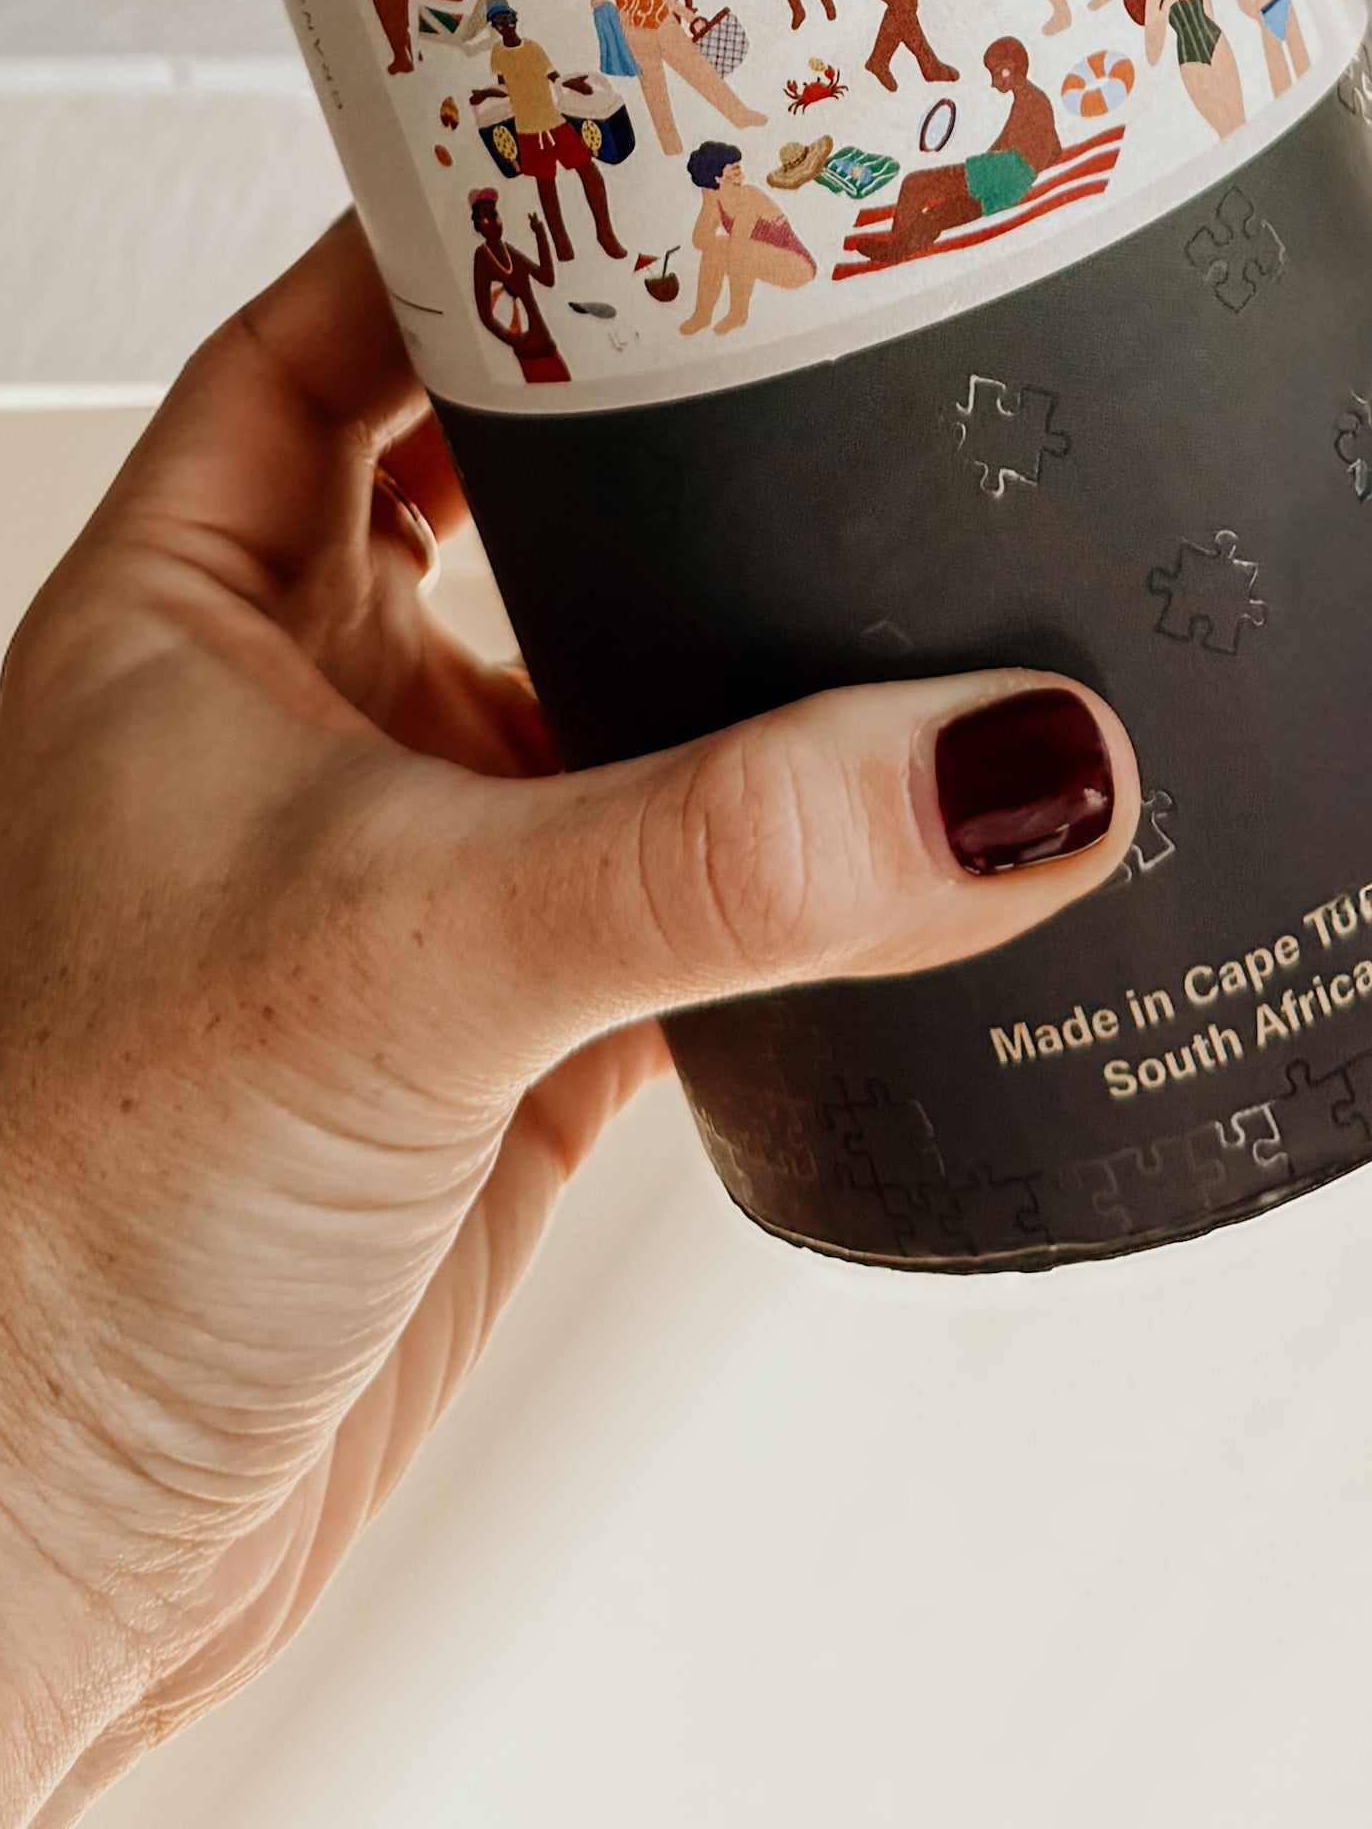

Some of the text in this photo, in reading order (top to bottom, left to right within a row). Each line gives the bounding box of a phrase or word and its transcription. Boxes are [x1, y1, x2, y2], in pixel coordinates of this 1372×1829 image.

[989, 1005, 1120, 1067] Made
[1126, 987, 1176, 1031] in
[1183, 932, 1300, 1003] Cape
[1102, 1023, 1244, 1100] South
